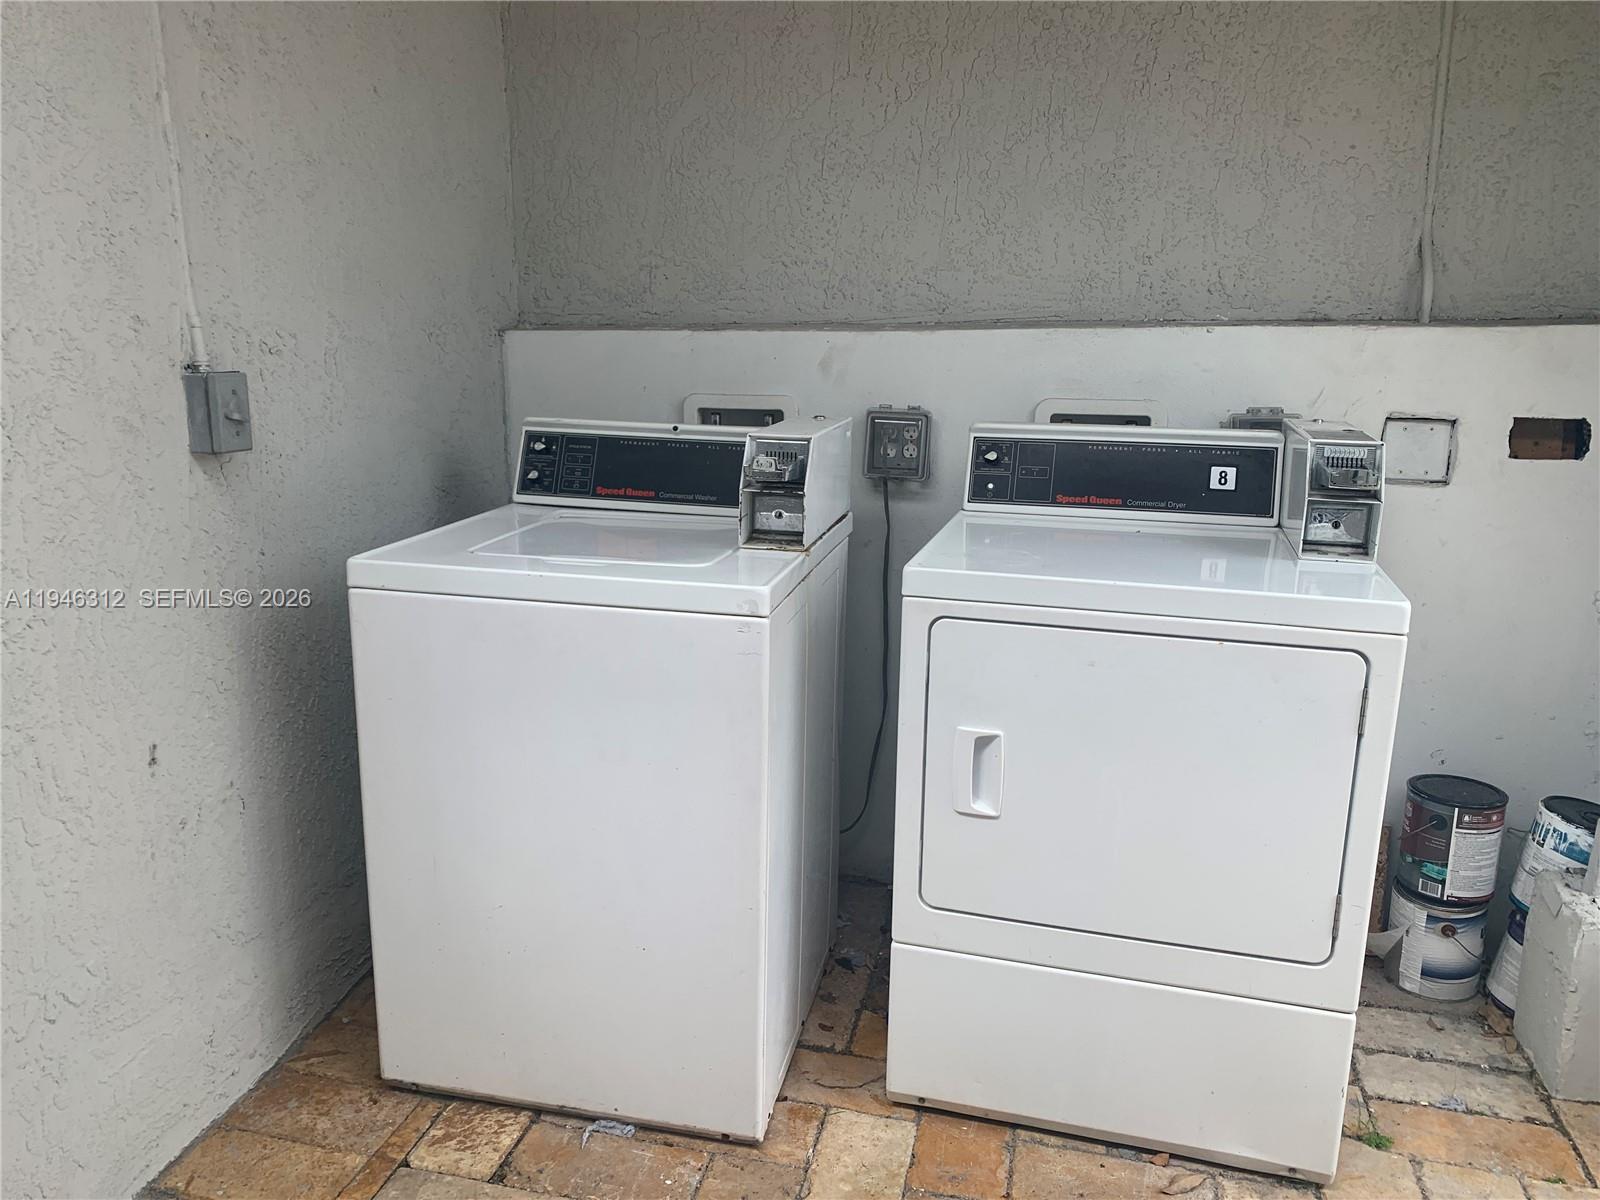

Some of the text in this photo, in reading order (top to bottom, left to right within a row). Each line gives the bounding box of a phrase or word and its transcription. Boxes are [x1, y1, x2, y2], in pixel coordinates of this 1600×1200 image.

[1218, 470, 1228, 486] 8
[595, 486, 656, 497] Speed Queen
[659, 491, 718, 501] Commercial Washer
[1056, 494, 1122, 505] Speed Queen
[1127, 499, 1187, 510] Commercial Dryer
